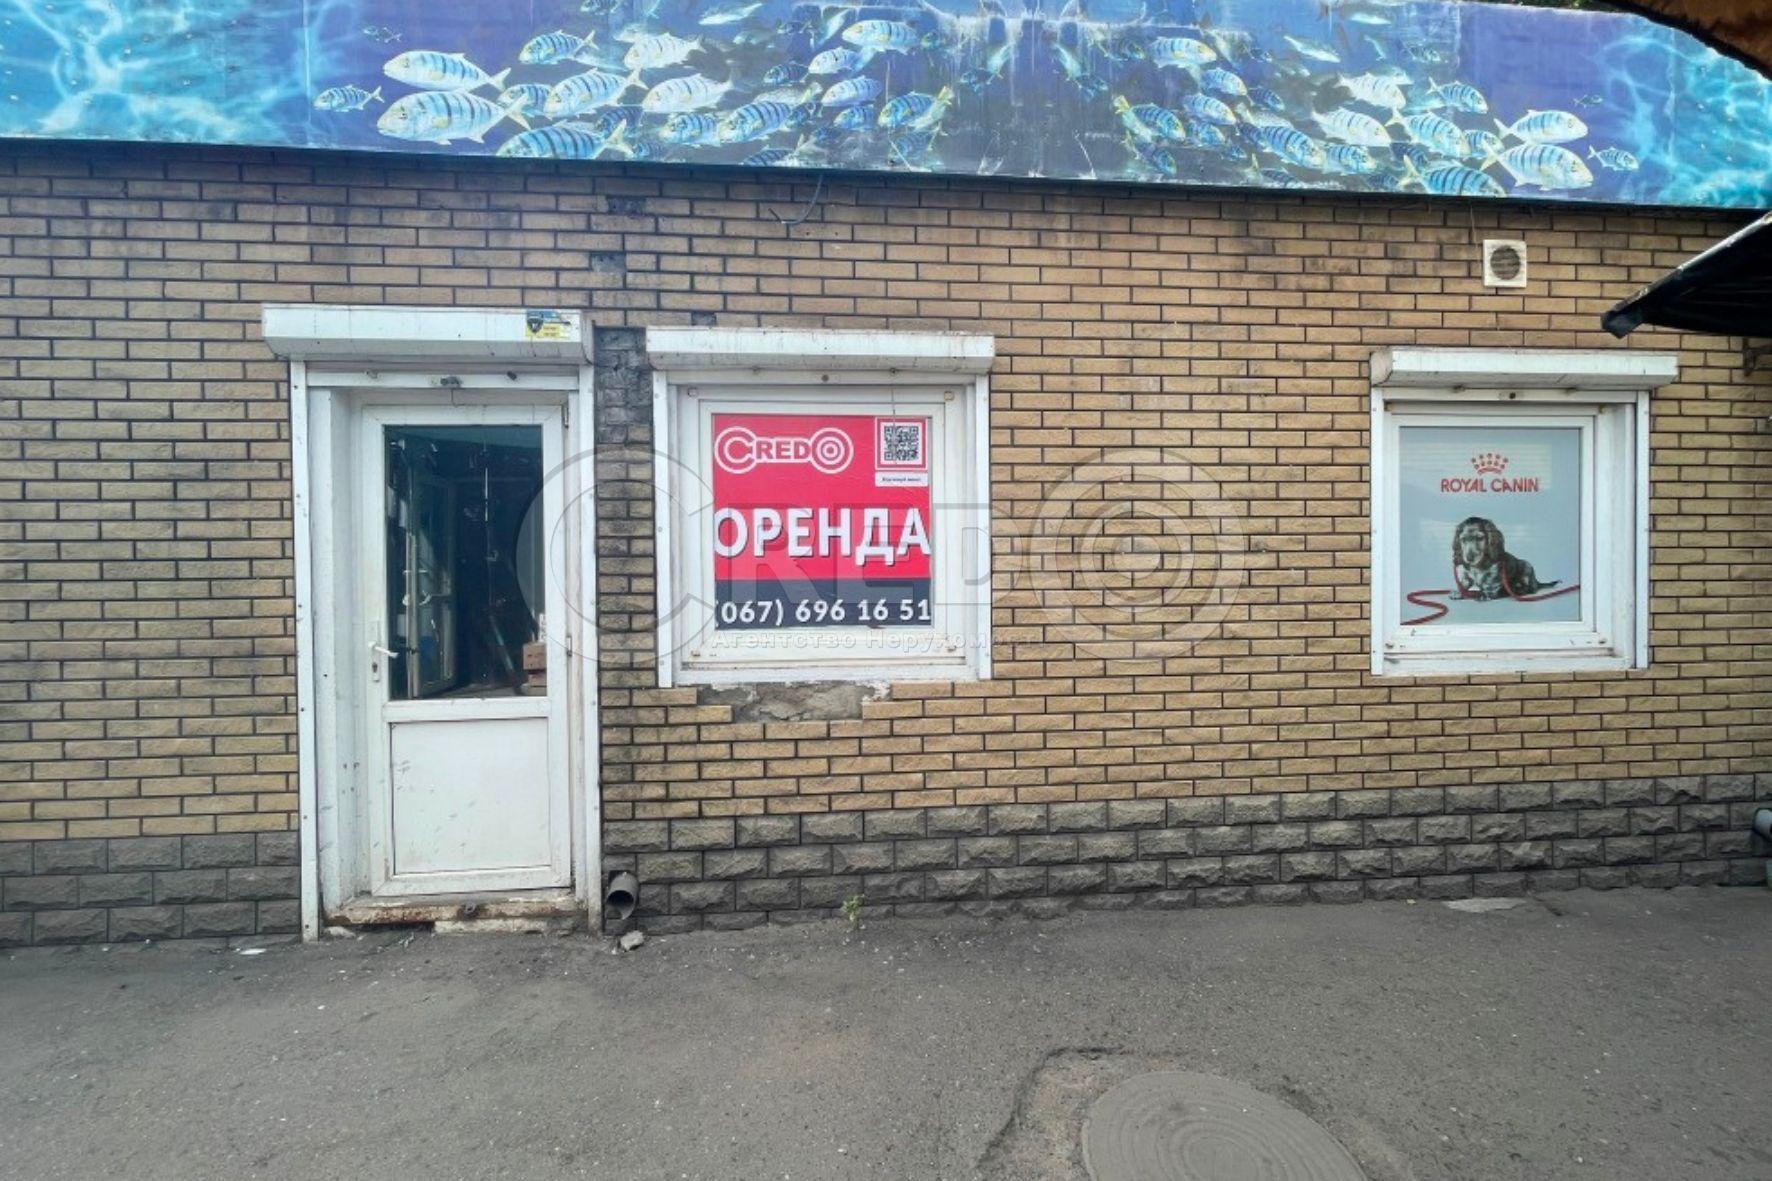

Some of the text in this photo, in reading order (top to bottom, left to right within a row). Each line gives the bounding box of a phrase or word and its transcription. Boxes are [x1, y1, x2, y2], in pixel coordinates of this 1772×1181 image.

[714, 426, 854, 474] CREDO
[1440, 478, 1539, 493] ROYAL CANIN
[714, 507, 932, 566] ОРЕНДА
[795, 598, 846, 622] 696
[857, 598, 889, 621] 16
[899, 598, 931, 621] 51
